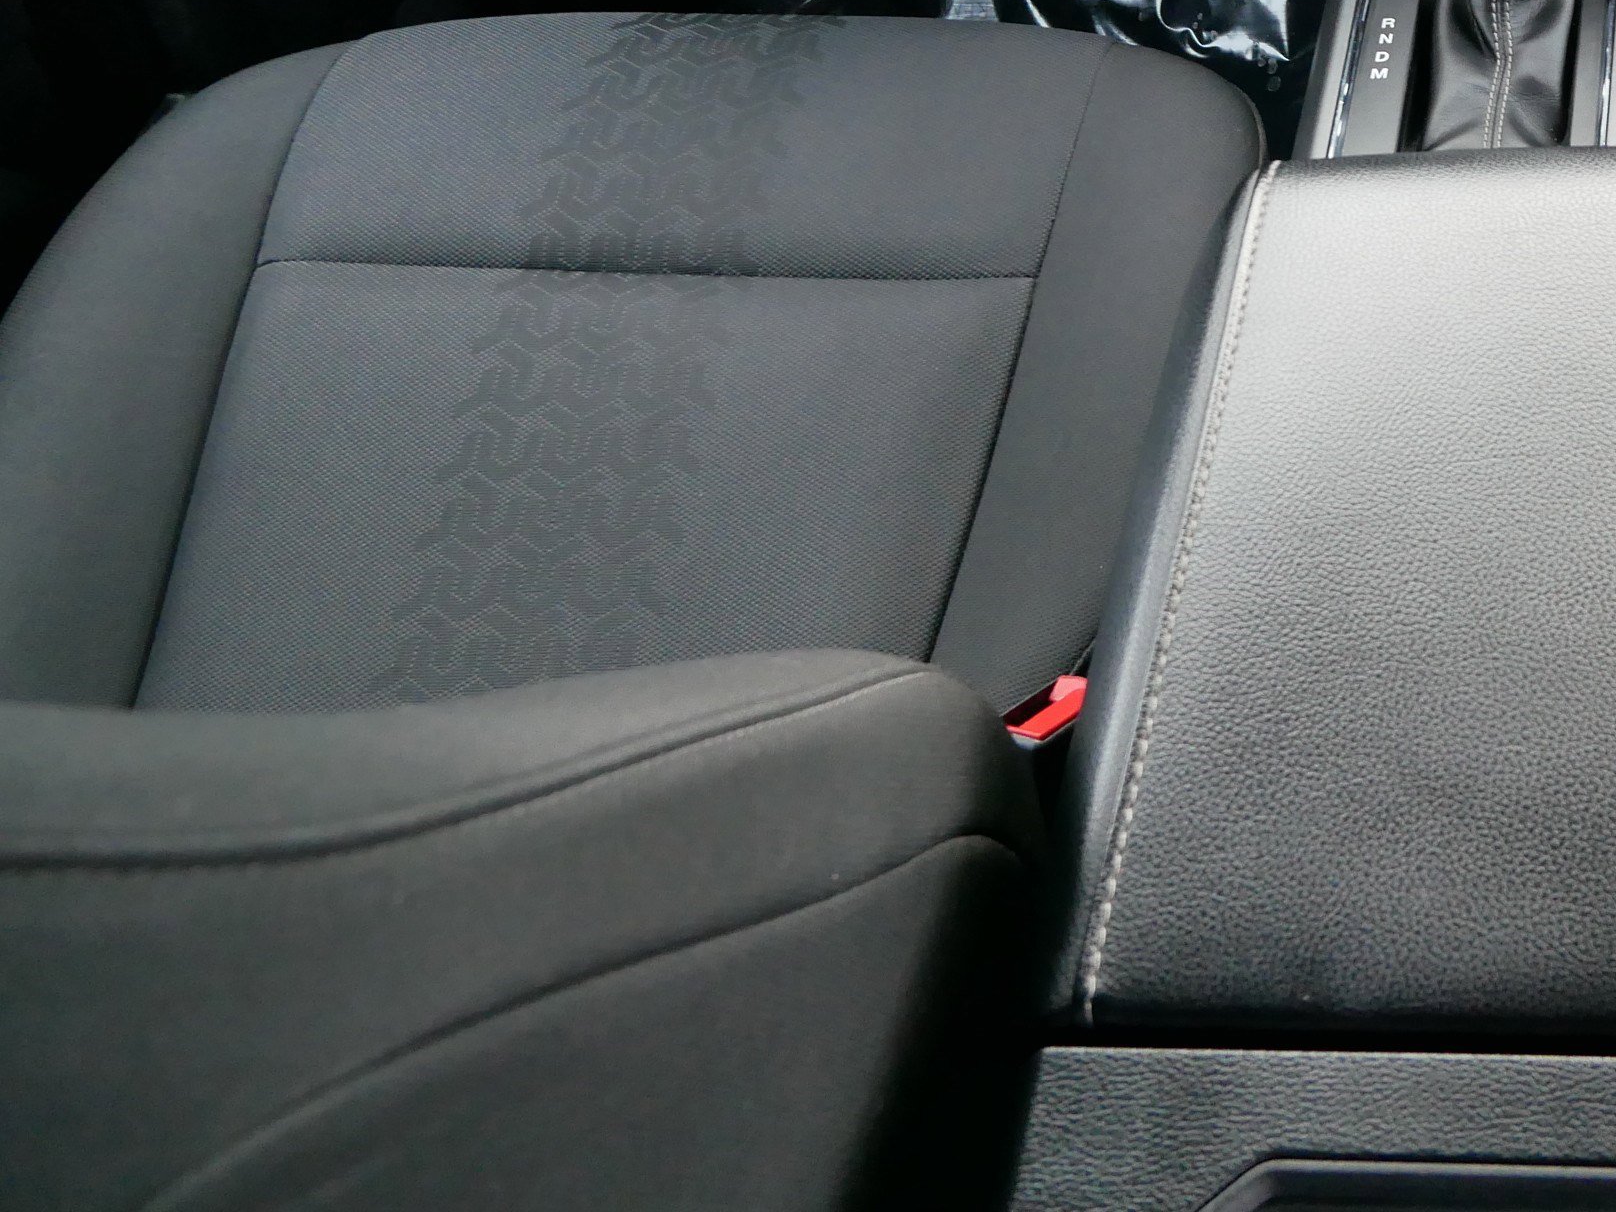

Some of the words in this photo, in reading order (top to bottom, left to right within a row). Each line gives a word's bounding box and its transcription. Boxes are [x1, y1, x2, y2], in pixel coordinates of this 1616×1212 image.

[1381, 17, 1396, 29] R
[1378, 33, 1393, 44] N
[1374, 51, 1390, 62] D
[1370, 67, 1389, 79] M
